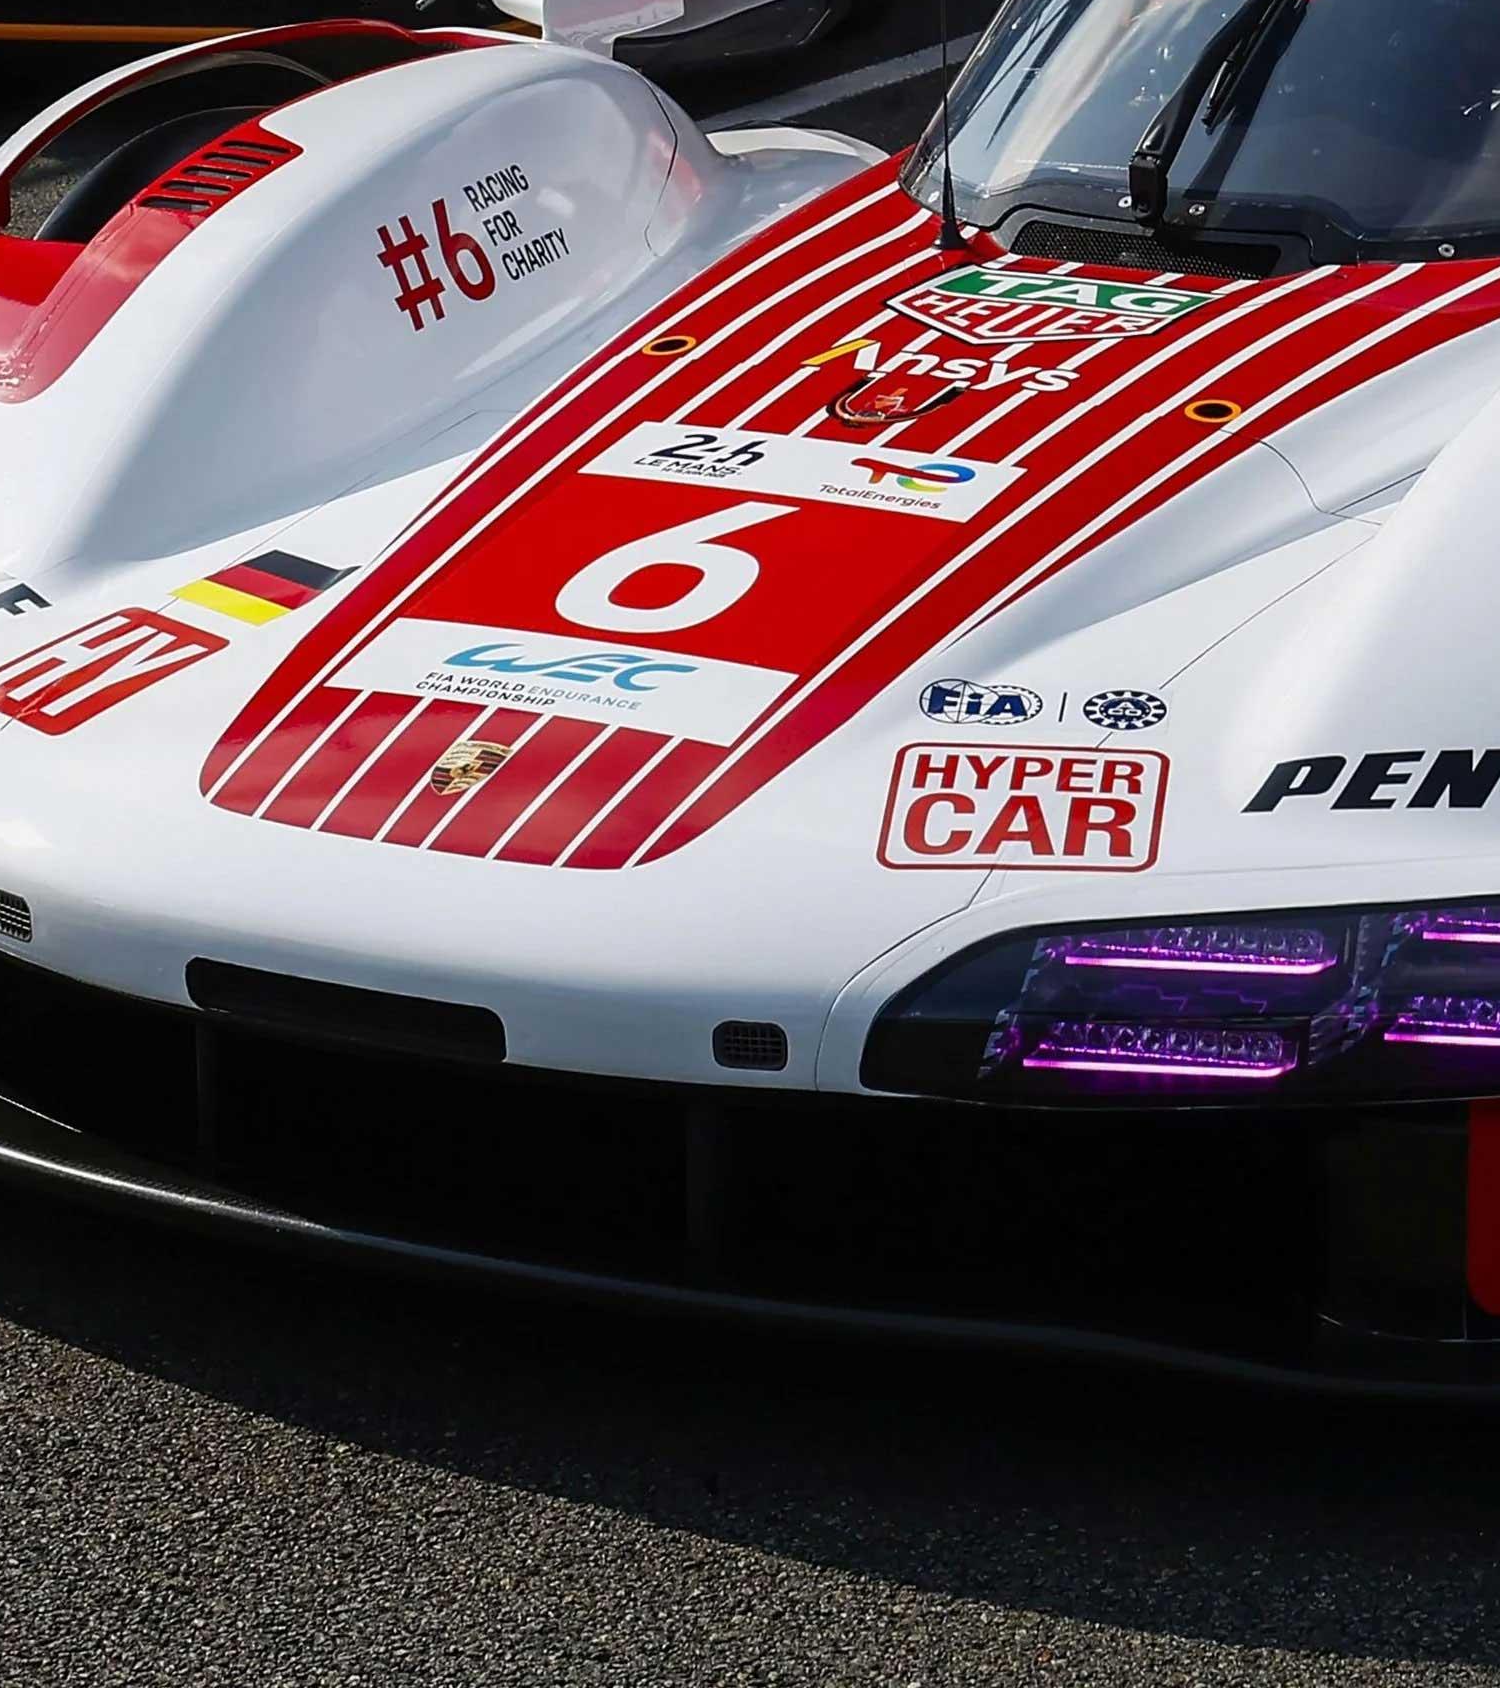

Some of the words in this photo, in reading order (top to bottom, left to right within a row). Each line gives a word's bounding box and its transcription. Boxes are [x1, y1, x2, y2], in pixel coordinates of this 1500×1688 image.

[463, 163, 530, 215] RACING
[487, 208, 524, 247] FOR
[376, 197, 498, 332] #6
[501, 226, 572, 283] CHARITY
[911, 292, 1165, 337] HEUER
[977, 274, 1192, 314] TAG
[800, 337, 1081, 393] Ansys
[633, 457, 667, 467] LE
[668, 461, 740, 475] MANS
[648, 433, 769, 467] 24h
[819, 483, 943, 511] TotalEnergies
[553, 501, 801, 634] 6
[441, 642, 701, 692] WEC
[415, 680, 557, 708] CHAMPIONSHIP
[424, 671, 455, 684] FIA
[460, 675, 526, 693] WORLD
[527, 684, 643, 712] ENDURANCE
[928, 686, 1030, 720] FIA
[912, 752, 1143, 795] HYPER
[904, 794, 1135, 858] CAR
